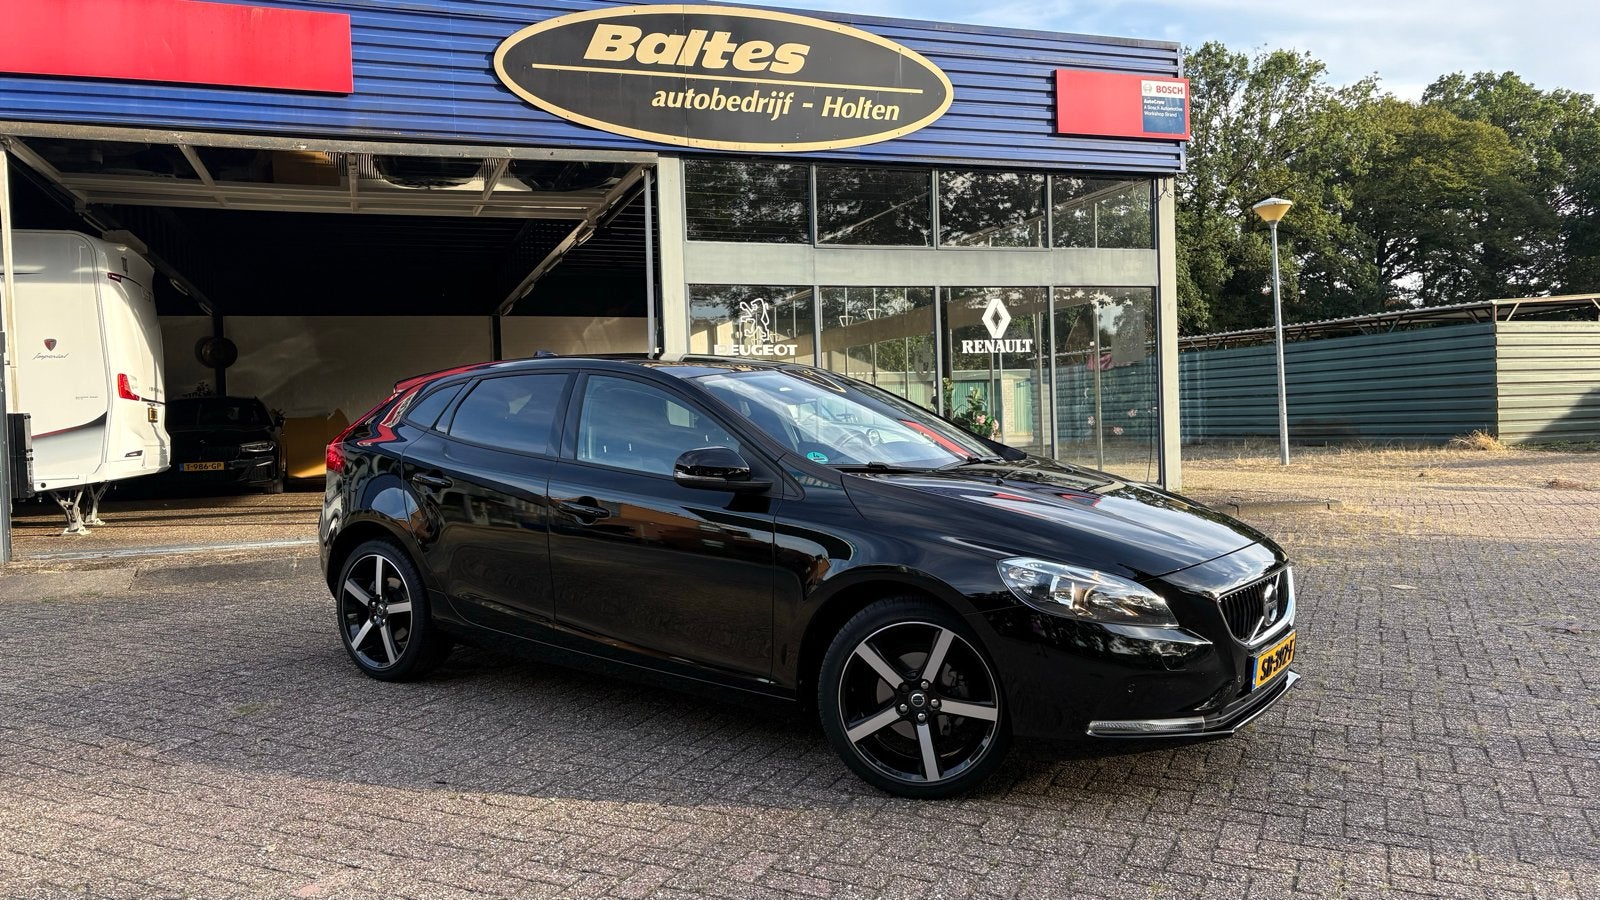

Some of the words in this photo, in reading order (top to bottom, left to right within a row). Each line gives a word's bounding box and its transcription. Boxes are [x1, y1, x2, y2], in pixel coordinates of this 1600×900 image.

[583, 24, 811, 74] Baltes
[1156, 85, 1183, 94] BOSCH
[651, 88, 794, 121] autobedrijf
[821, 96, 900, 121] Holten
[714, 344, 798, 356] PEUGEOT
[961, 338, 1033, 354] RENAULT
